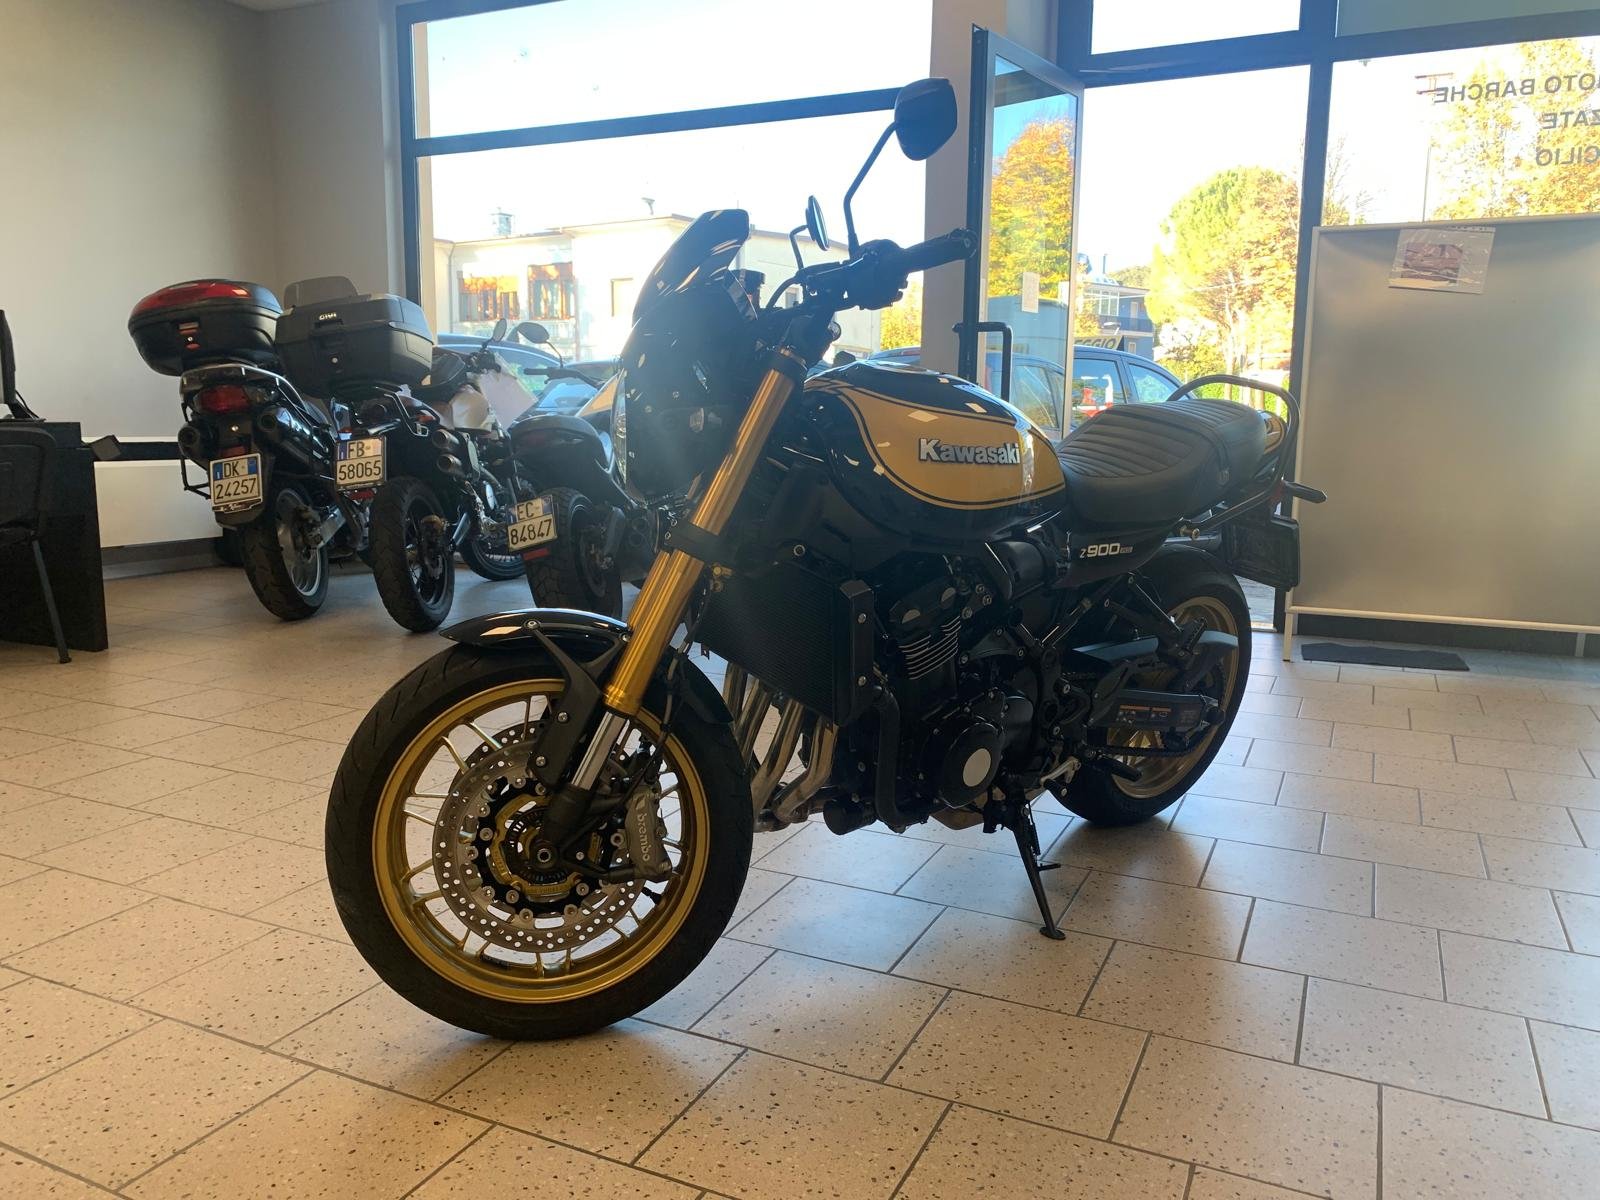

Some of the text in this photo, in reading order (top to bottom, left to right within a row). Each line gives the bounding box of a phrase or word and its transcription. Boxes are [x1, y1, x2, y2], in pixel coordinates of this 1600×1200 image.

[348, 441, 365, 458] FB
[918, 437, 1020, 465] Kawasaki
[223, 461, 240, 478] DK
[338, 460, 381, 481] 58065
[215, 477, 257, 500] 24257
[516, 501, 535, 520] EC
[510, 518, 552, 545] 84847
[637, 812, 652, 862] brembo
